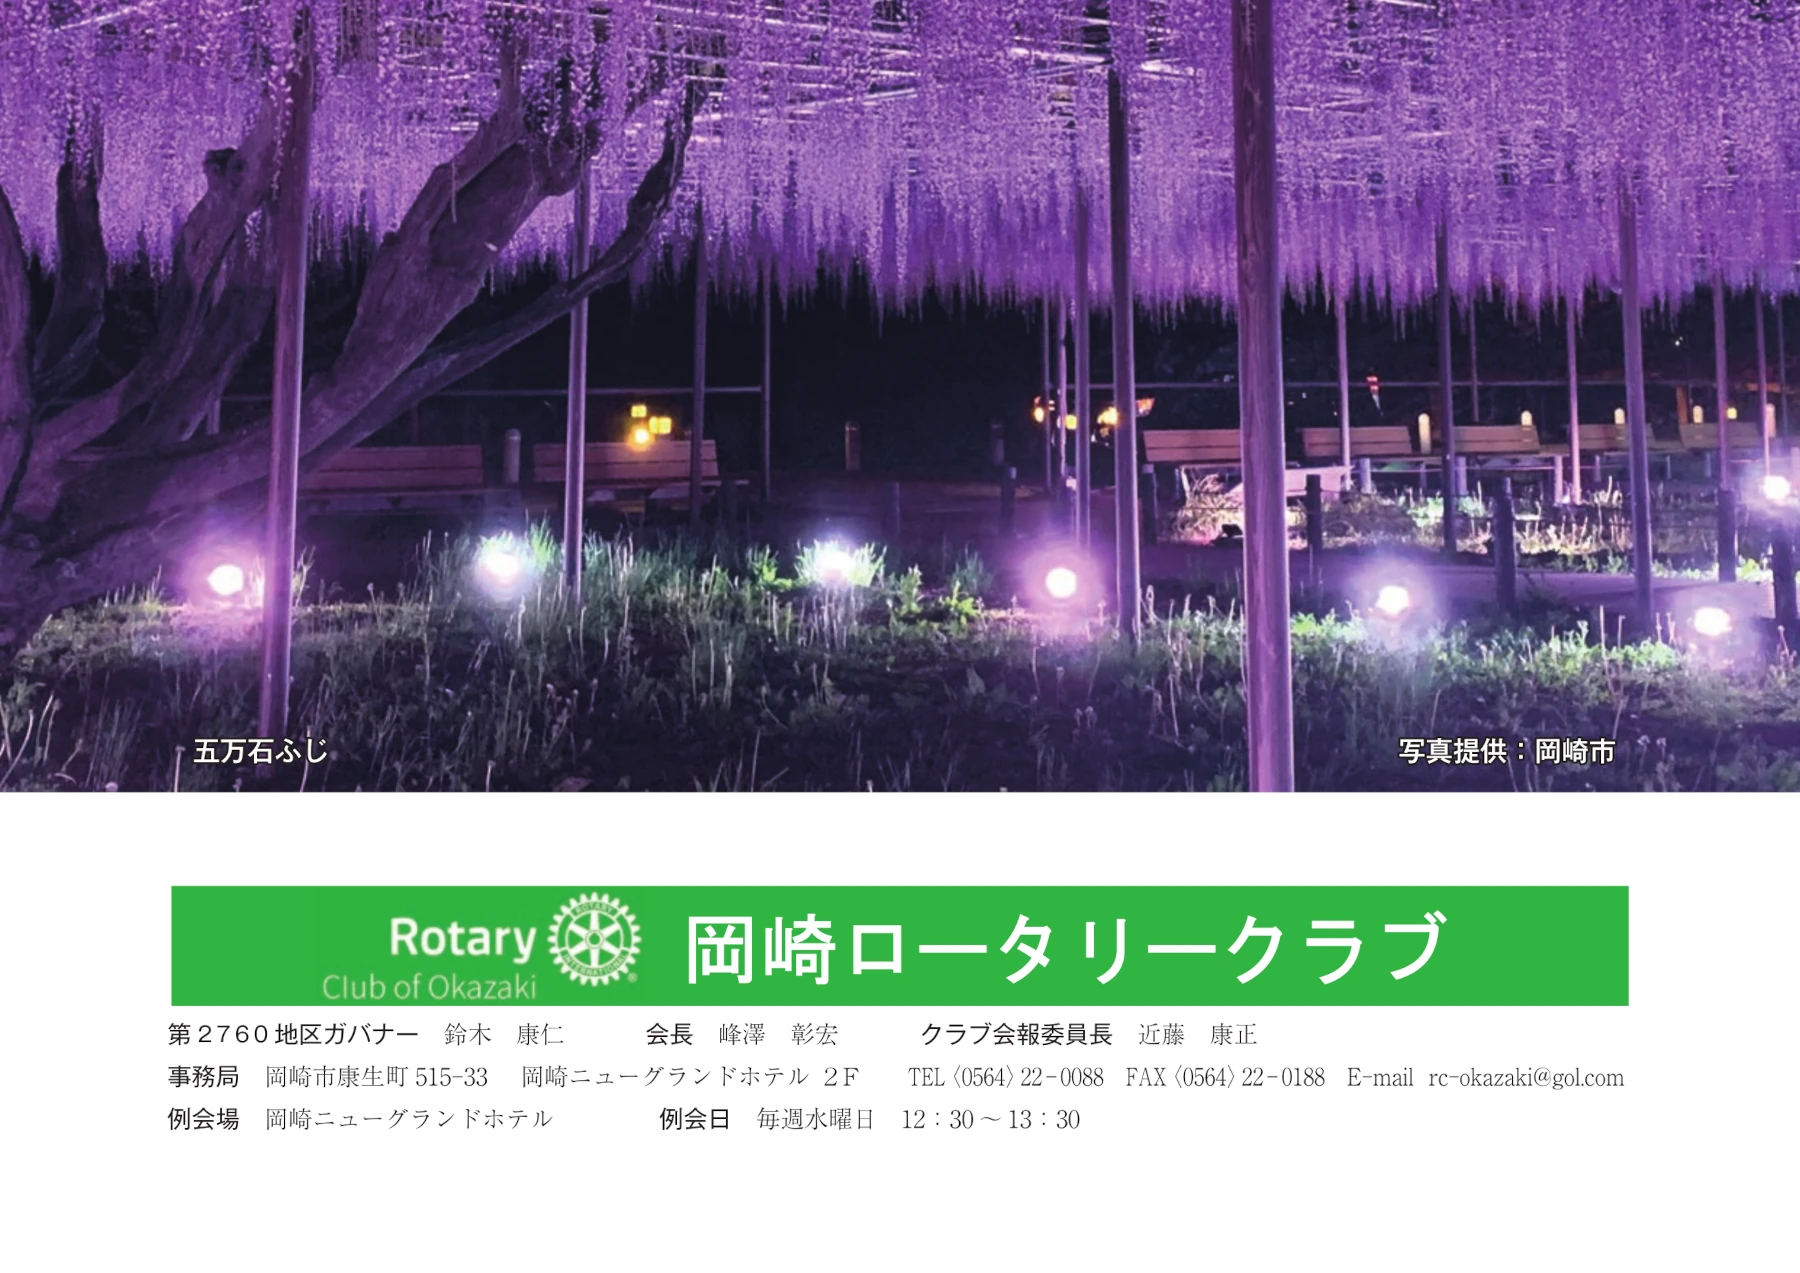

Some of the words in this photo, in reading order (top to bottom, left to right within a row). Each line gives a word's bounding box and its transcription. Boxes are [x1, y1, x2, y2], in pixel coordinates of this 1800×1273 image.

[390, 917, 537, 965] Rotary
[688, 912, 1447, 986] 岡崎ロータリークラブ
[322, 973, 387, 1000] Club
[393, 973, 422, 1000] of
[427, 973, 537, 1000] Okazaki
[444, 1022, 492, 1046] 鈴木
[517, 1022, 564, 1046] 康仁
[646, 1022, 694, 1046] 会長
[719, 1022, 766, 1046] 峰澤
[791, 1022, 838, 1046] 彰宏
[921, 1021, 1113, 1046] クラブ会報委員長
[1139, 1022, 1185, 1046] 近藤
[1210, 1022, 1257, 1046] 康正
[167, 1064, 239, 1089] 事務局
[1347, 1066, 1414, 1087] E-mail
[1428, 1066, 1625, 1090] rc-okazaki@gol.com
[167, 1107, 240, 1131] 例会場
[266, 1107, 553, 1131] 岡崎ニューグランドホテル
[659, 1107, 729, 1131] 例会日
[757, 1107, 873, 1131] 毎週水曜日
